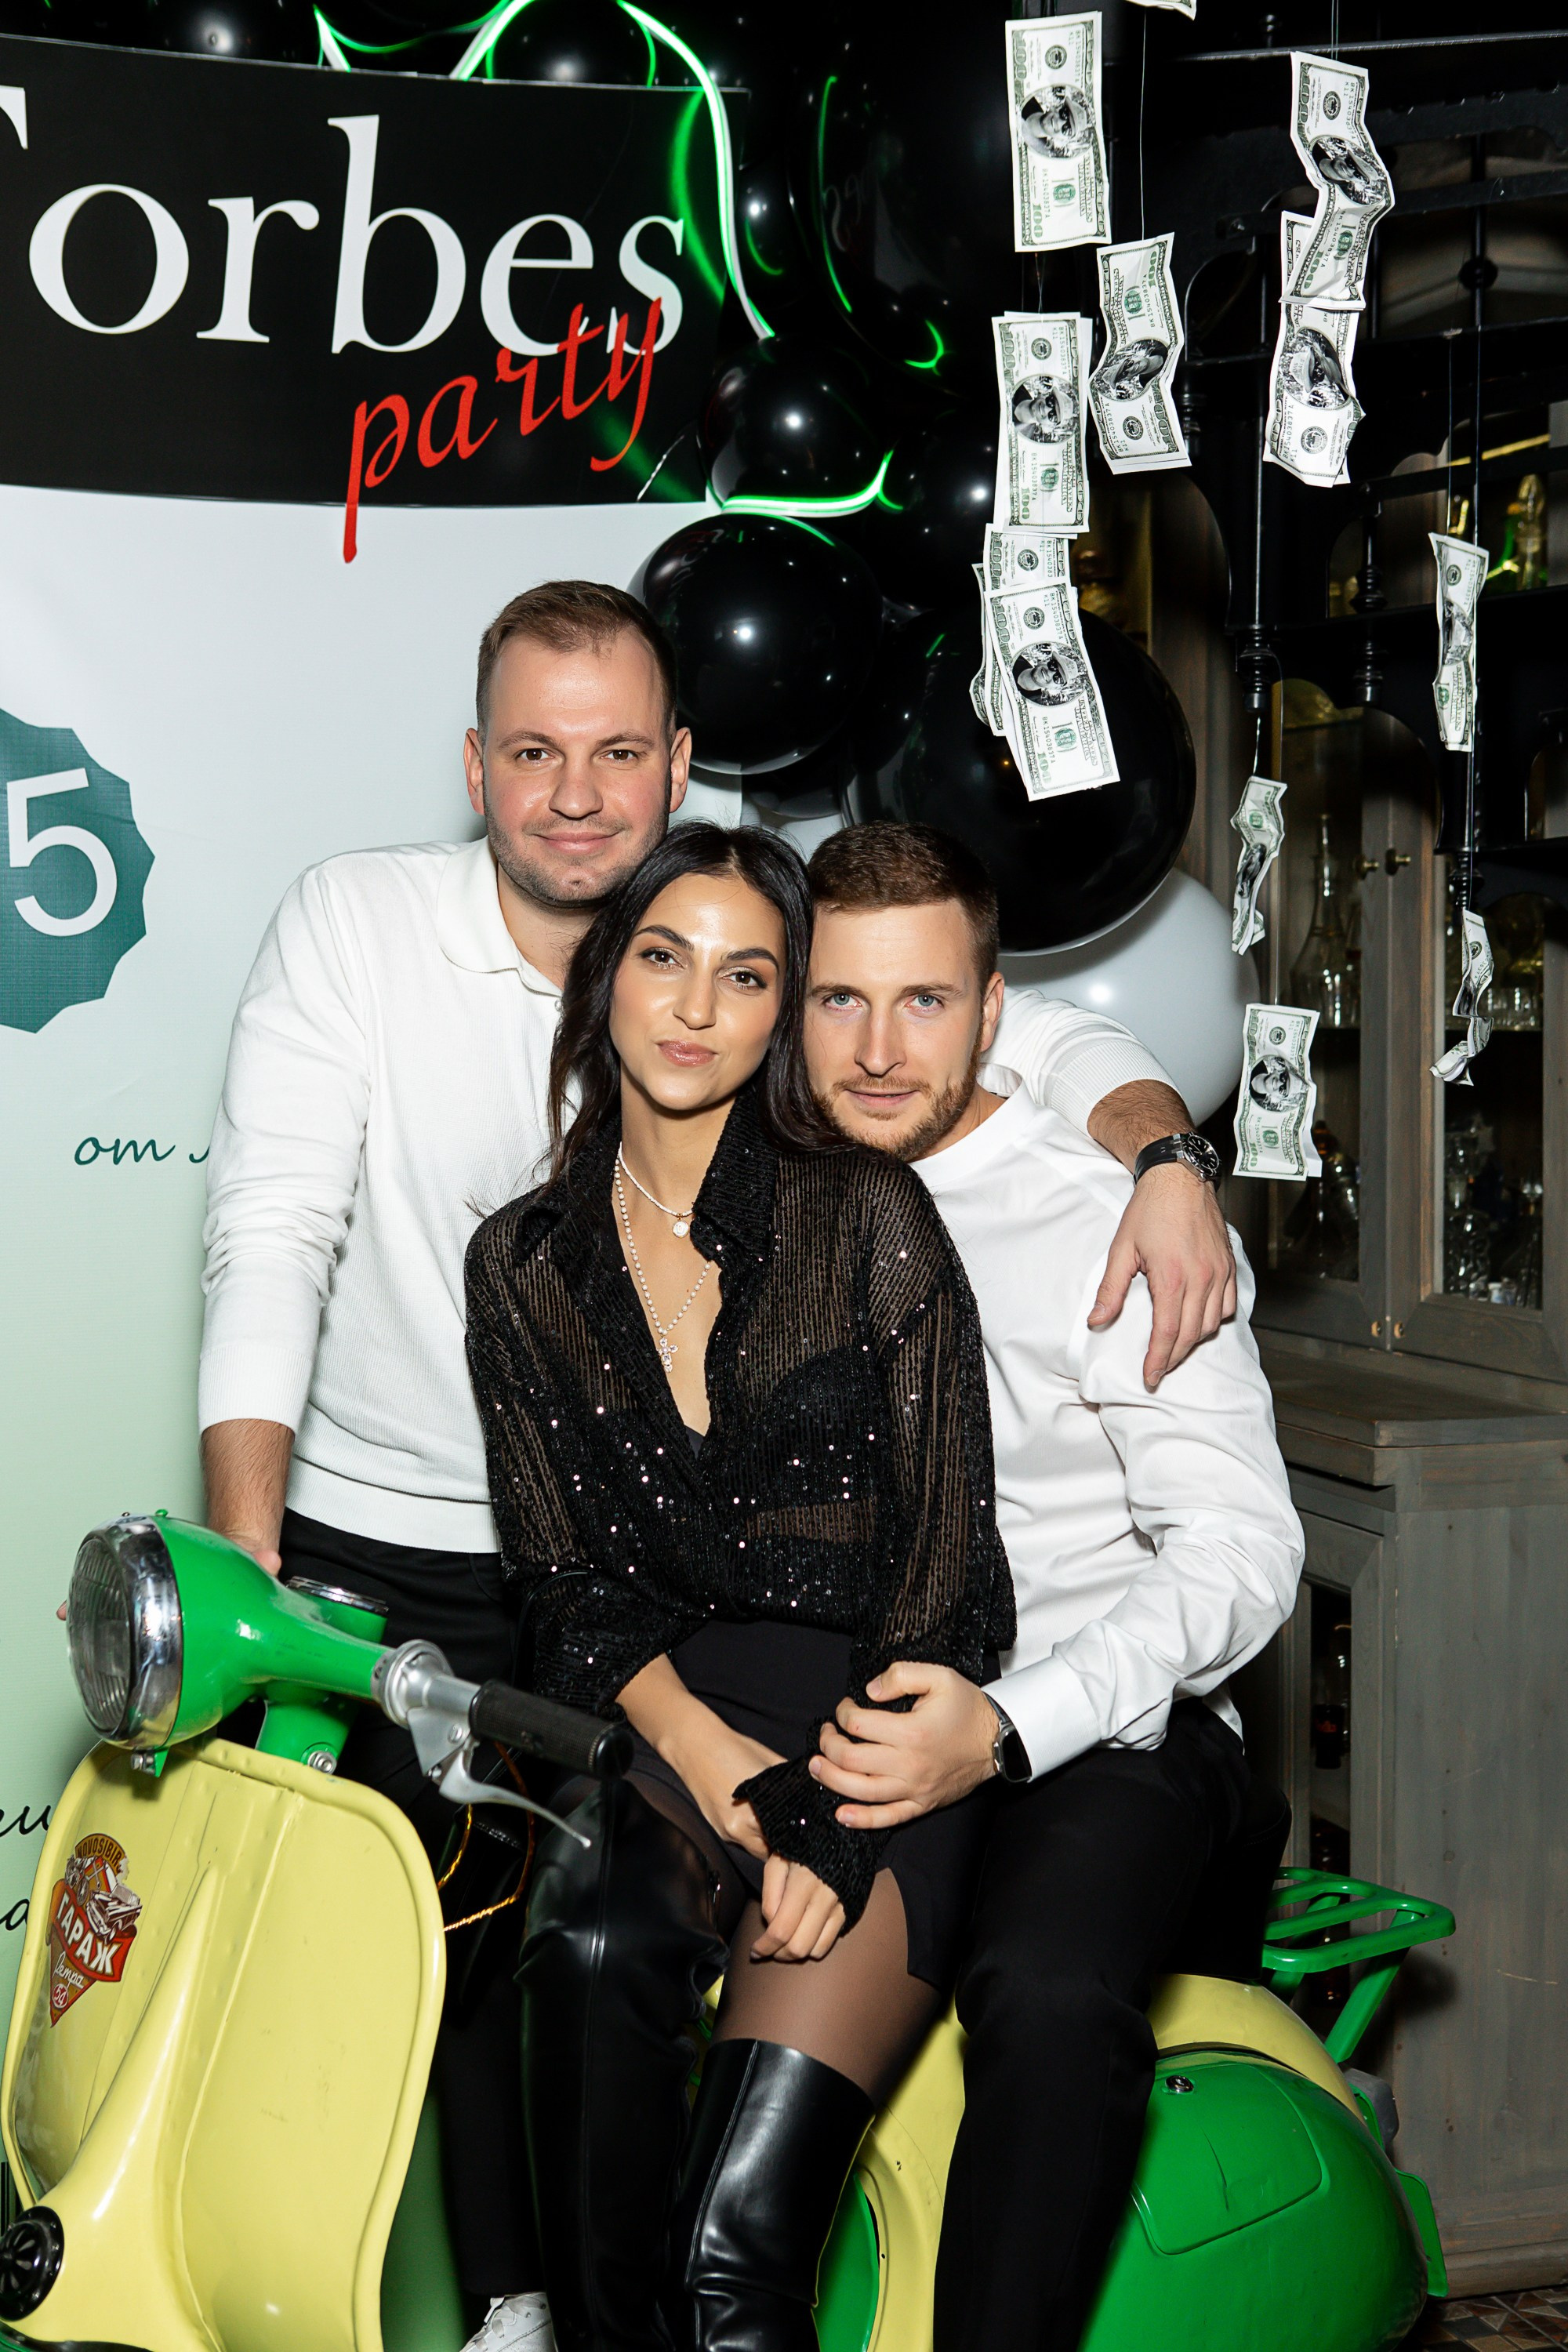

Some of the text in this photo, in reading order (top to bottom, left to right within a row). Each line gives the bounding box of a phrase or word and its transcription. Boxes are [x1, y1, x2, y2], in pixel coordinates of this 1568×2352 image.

[1014, 38, 1027, 81] 100
[1299, 73, 1310, 124] 100
[0, 86, 684, 356] orbes
[1033, 204, 1044, 238] 100
[1148, 251, 1156, 288] 100
[1304, 250, 1324, 289] 100
[1002, 331, 1016, 369] 100
[343, 296, 663, 564] party
[1153, 402, 1175, 445] 100
[1022, 487, 1030, 520] 100
[992, 540, 1002, 577] 100
[993, 604, 1011, 643] 100
[1037, 751, 1052, 784] 100
[1249, 1142, 1258, 1167] 100
[56, 1892, 122, 1976] ГАРАЖ
